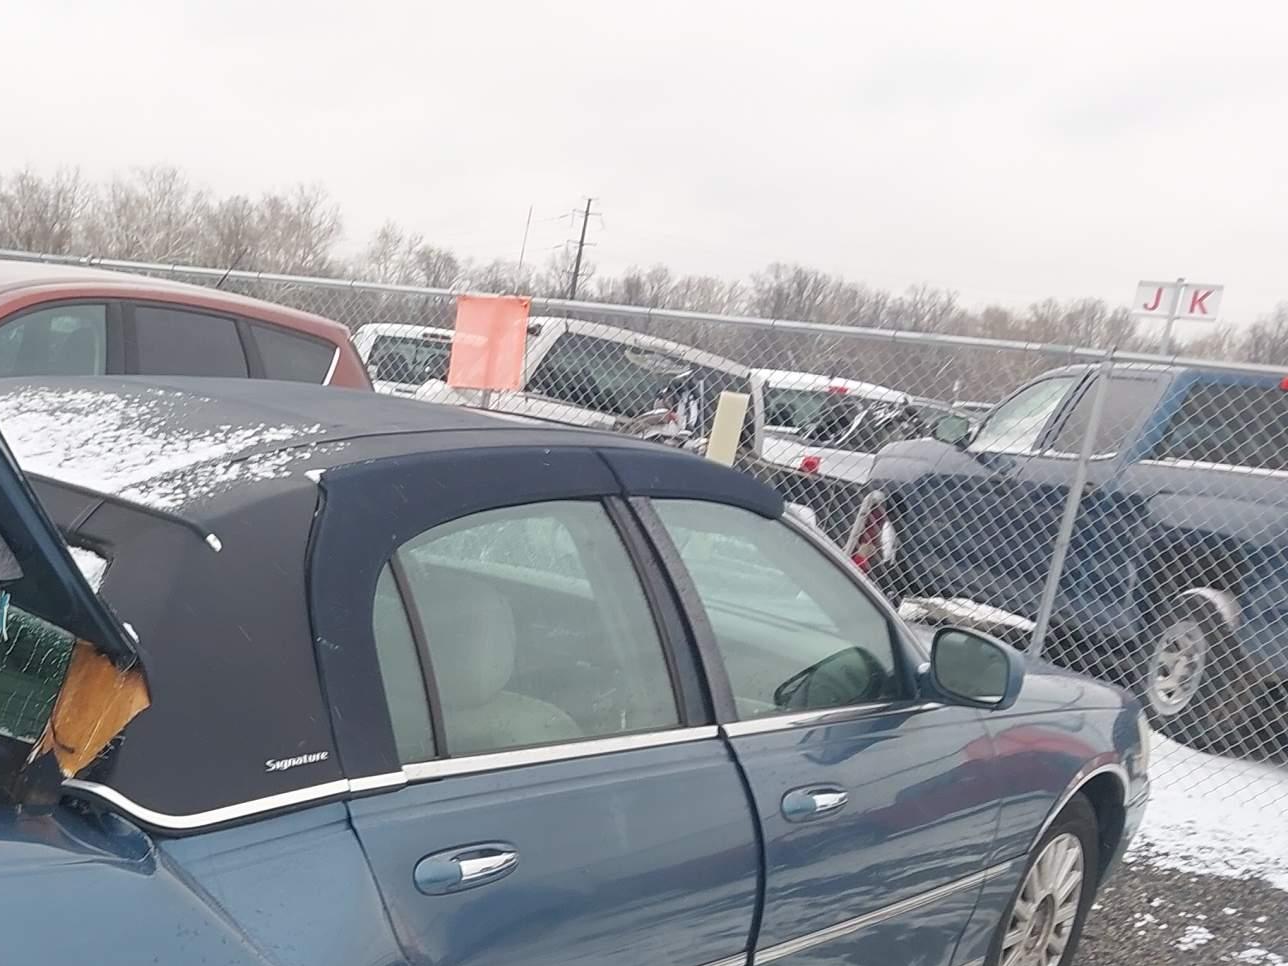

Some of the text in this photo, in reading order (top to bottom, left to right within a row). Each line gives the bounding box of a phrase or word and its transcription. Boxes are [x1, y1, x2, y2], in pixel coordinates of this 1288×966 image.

[1142, 287, 1216, 314] J K
[265, 751, 329, 772] Signature
